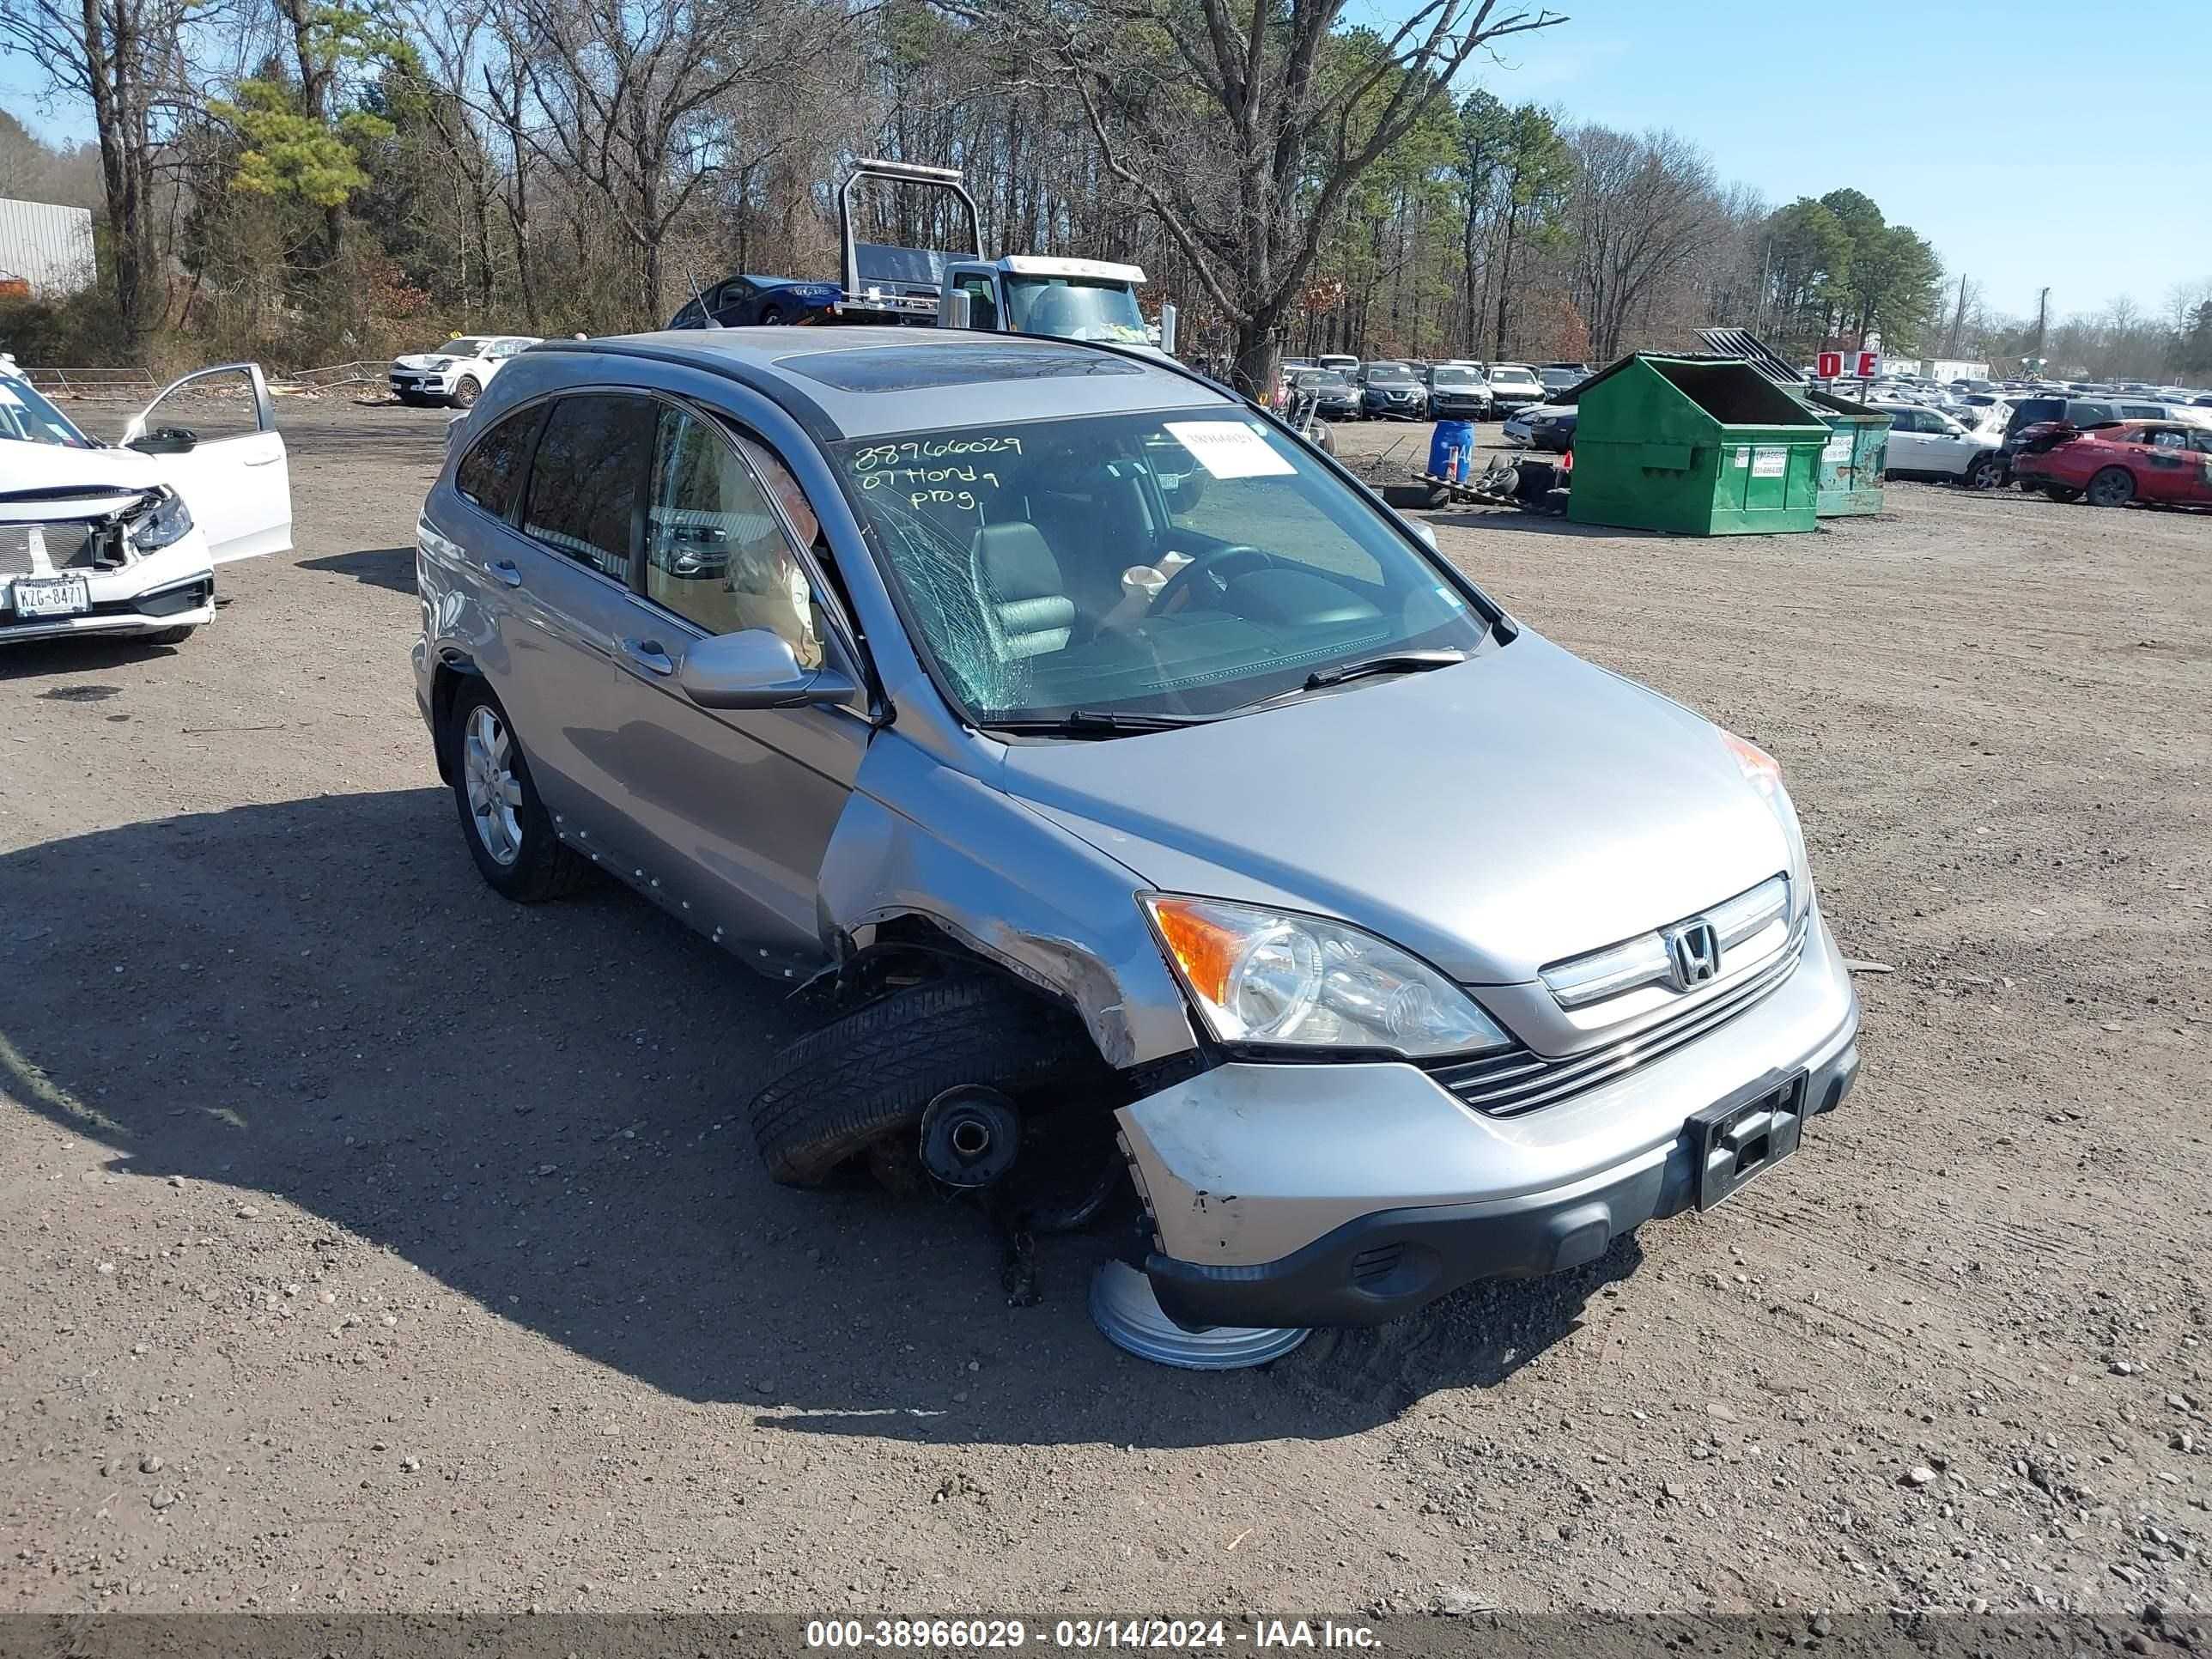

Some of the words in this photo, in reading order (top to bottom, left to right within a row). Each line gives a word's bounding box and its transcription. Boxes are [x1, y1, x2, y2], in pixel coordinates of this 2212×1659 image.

[1858, 353, 1877, 376] E
[855, 438, 1022, 471] 38966029
[863, 470, 894, 489] 07
[910, 489, 975, 509] prog
